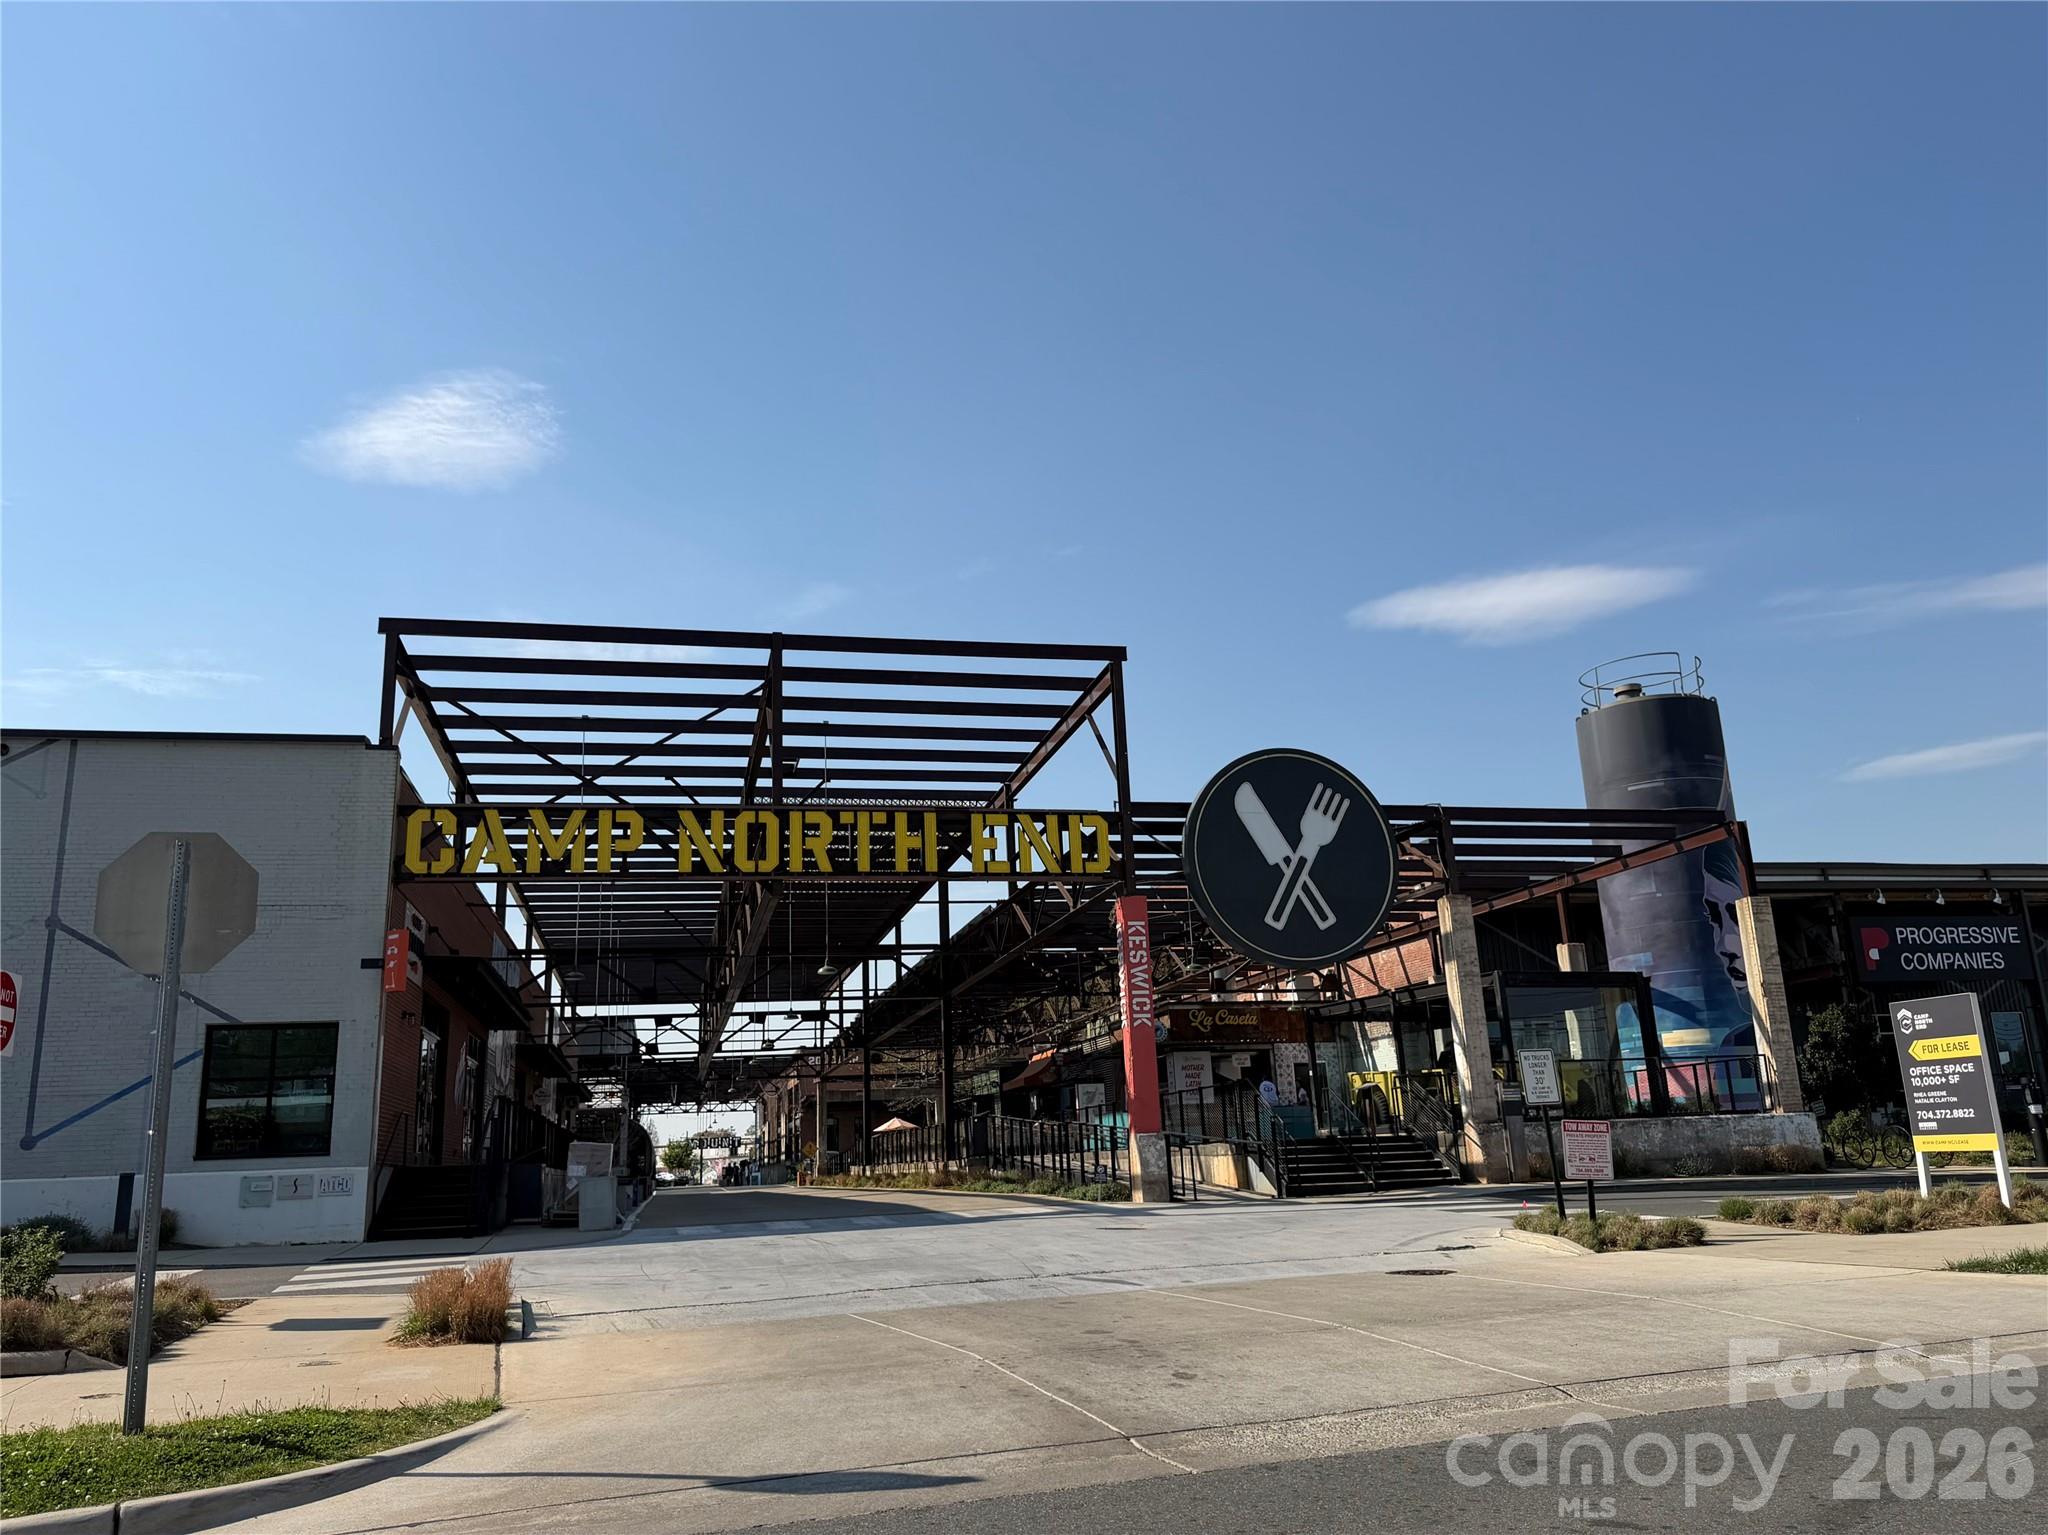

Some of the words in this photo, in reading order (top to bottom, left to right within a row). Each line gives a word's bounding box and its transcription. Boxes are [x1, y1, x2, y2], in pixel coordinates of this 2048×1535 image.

[403, 808, 645, 875] CAMP
[677, 809, 938, 875] NORTH
[970, 812, 1112, 875] END
[1896, 926, 2021, 945] PROGRESSIVE
[1900, 951, 2005, 971] COMPANIES
[1126, 920, 1152, 1028] KESWICK
[1188, 1009, 1214, 1033] La
[1215, 1009, 1259, 1025] Caseta
[1921, 1043, 1940, 1055] FOR
[1941, 1041, 1970, 1053] LEASE
[1181, 1063, 1205, 1072] MOTHER
[1909, 1066, 1942, 1077] OFFICE
[1943, 1063, 1975, 1074] SPACE
[1185, 1080, 1201, 1088] LATIN
[1910, 1076, 1947, 1087] 10,000+
[1948, 1075, 1960, 1084] SF
[1916, 1108, 1975, 1120] 704.372.8822
[1564, 1122, 1577, 1131] TOW
[1578, 1122, 1593, 1131] AWAY
[1593, 1123, 1608, 1132] ZONE
